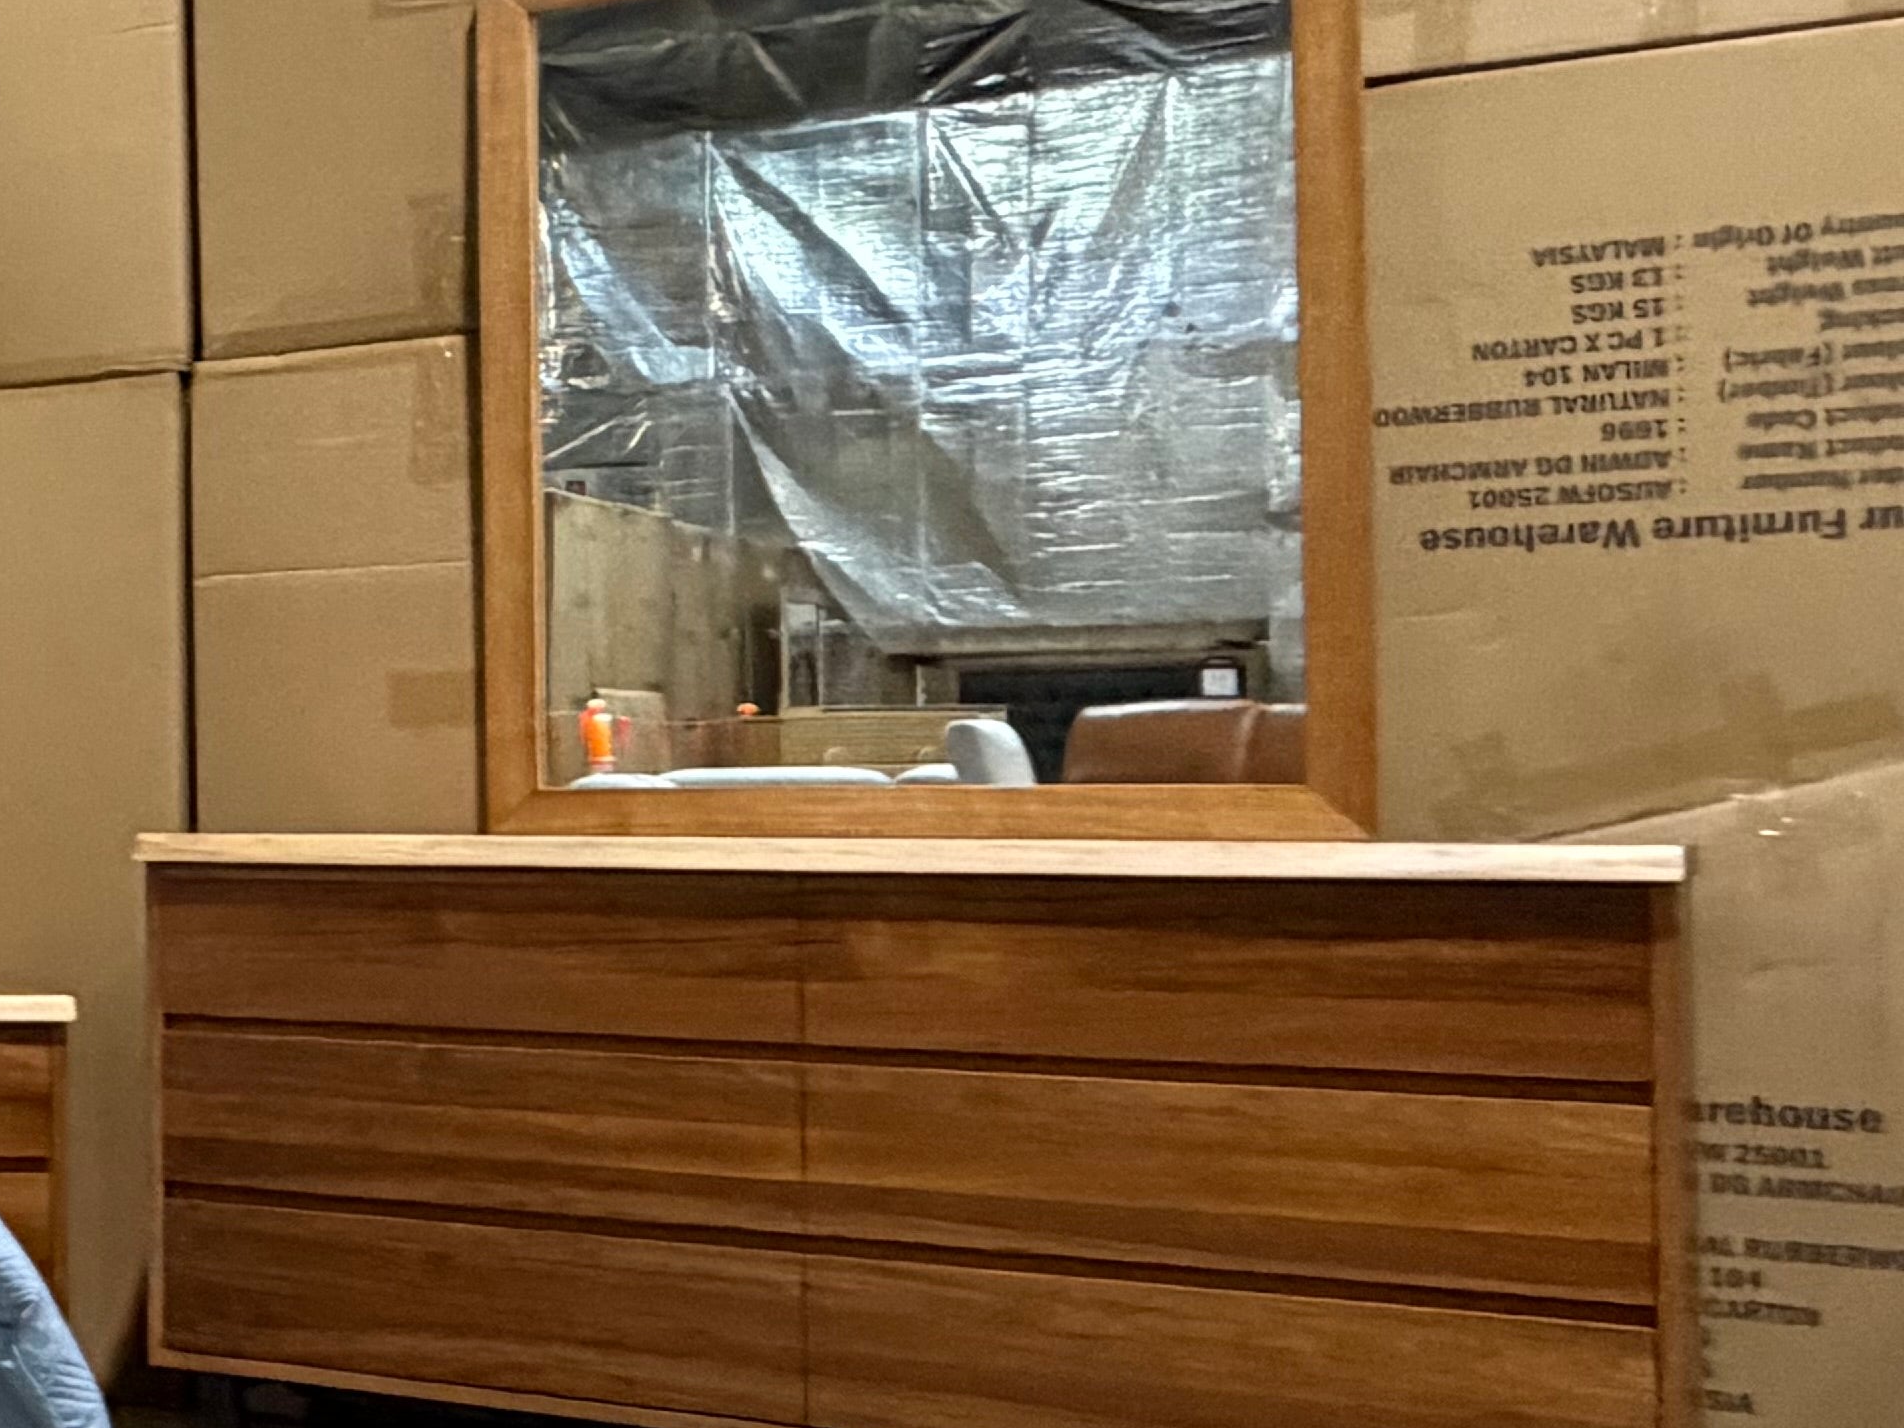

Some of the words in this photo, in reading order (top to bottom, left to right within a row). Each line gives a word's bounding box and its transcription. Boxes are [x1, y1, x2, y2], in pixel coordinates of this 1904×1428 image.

[1373, 397, 1542, 428] RUBBERWOO
[1652, 509, 1847, 543] Furniture
[1858, 505, 1904, 530] ur
[1420, 519, 1640, 553] Warehouse
